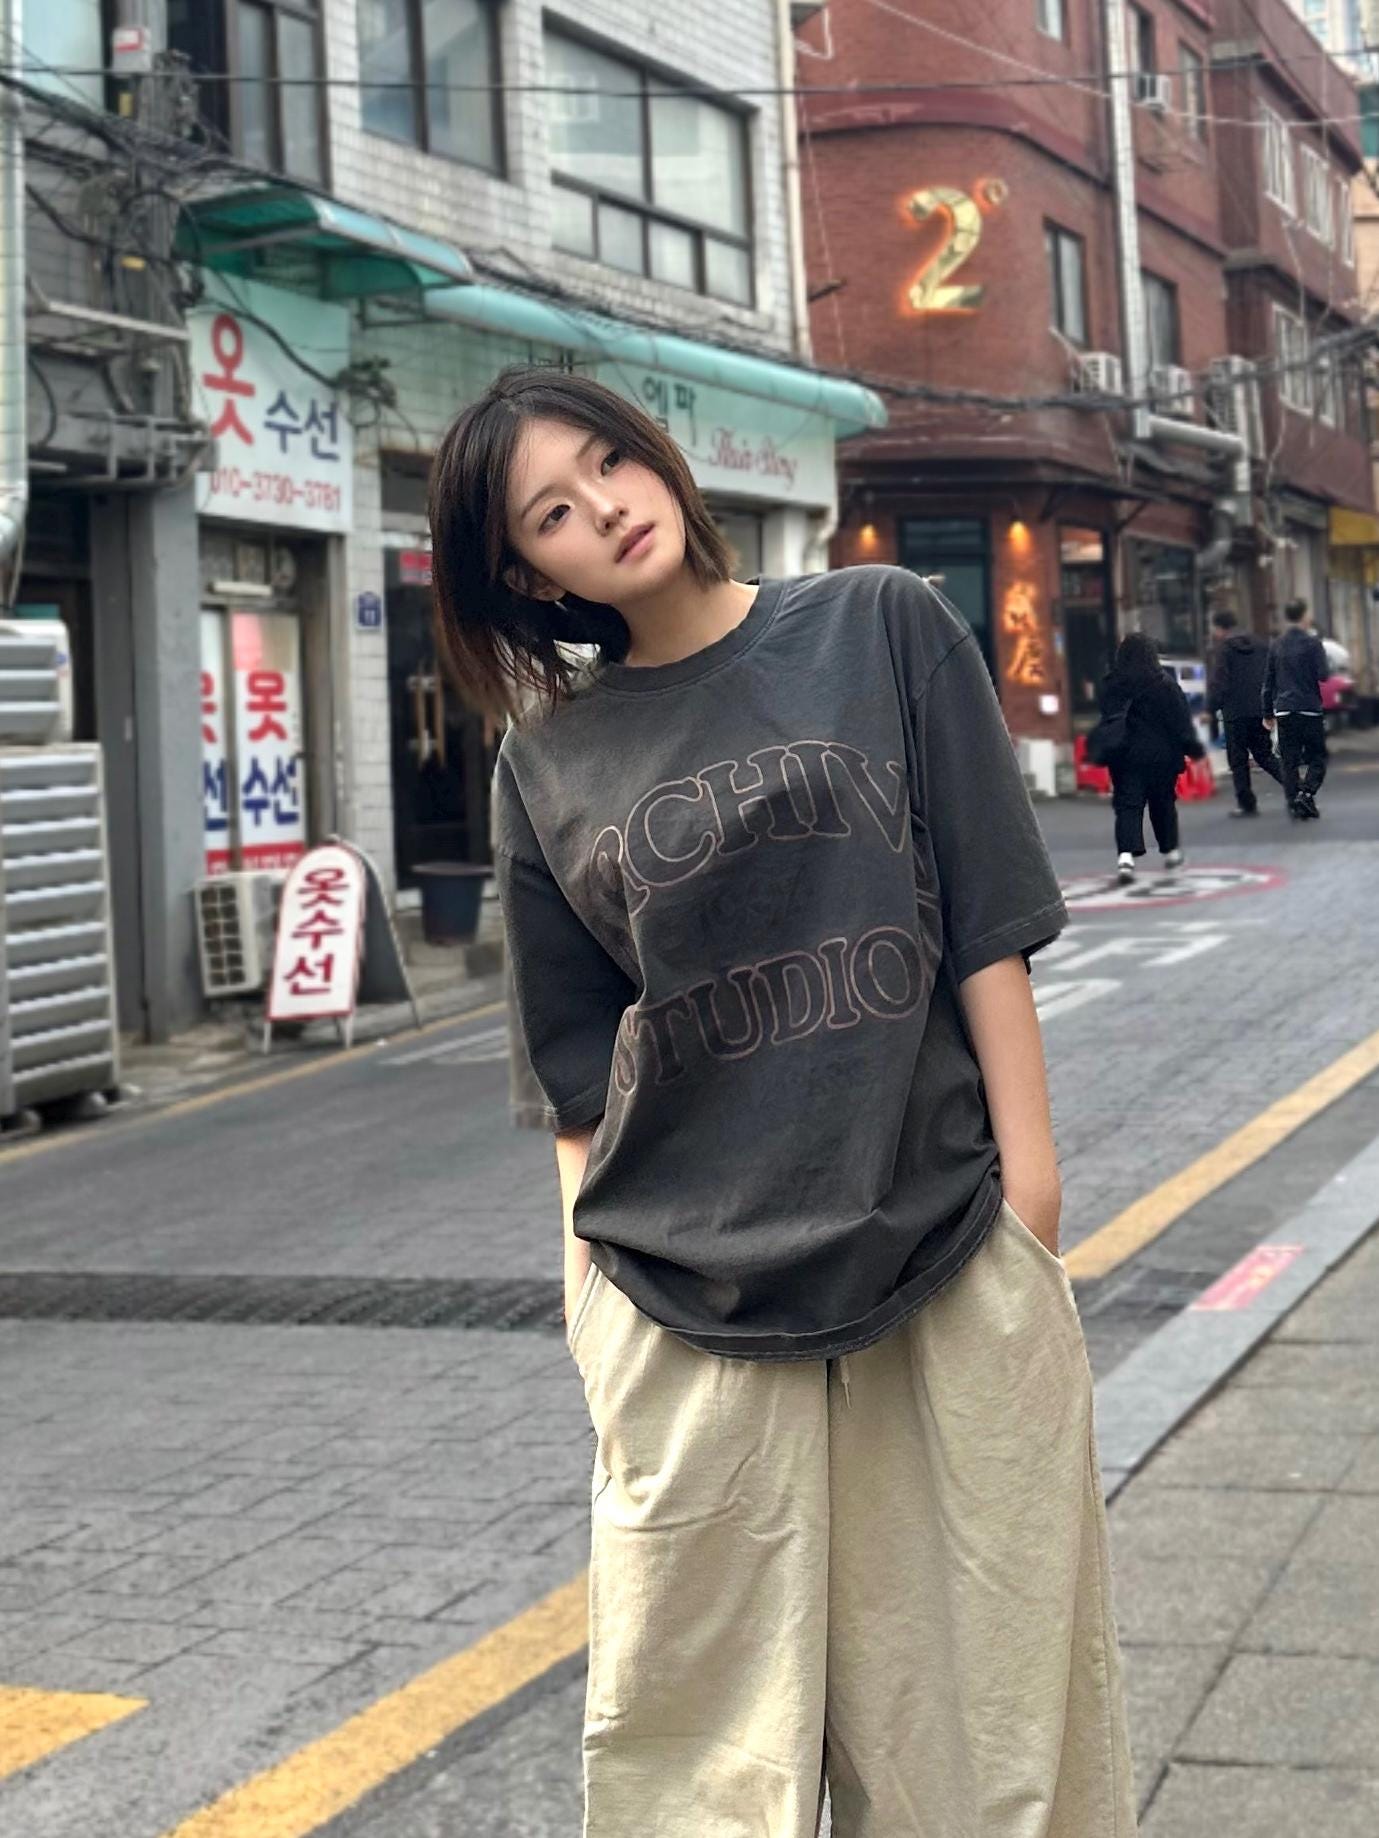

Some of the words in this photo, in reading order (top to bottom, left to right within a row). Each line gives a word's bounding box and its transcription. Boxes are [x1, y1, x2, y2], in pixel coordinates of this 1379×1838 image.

[203, 313, 256, 446] 옷
[264, 389, 341, 462] 수선
[245, 670, 288, 743] 옷
[241, 755, 300, 827] 수선
[283, 868, 350, 996] 옷수선
